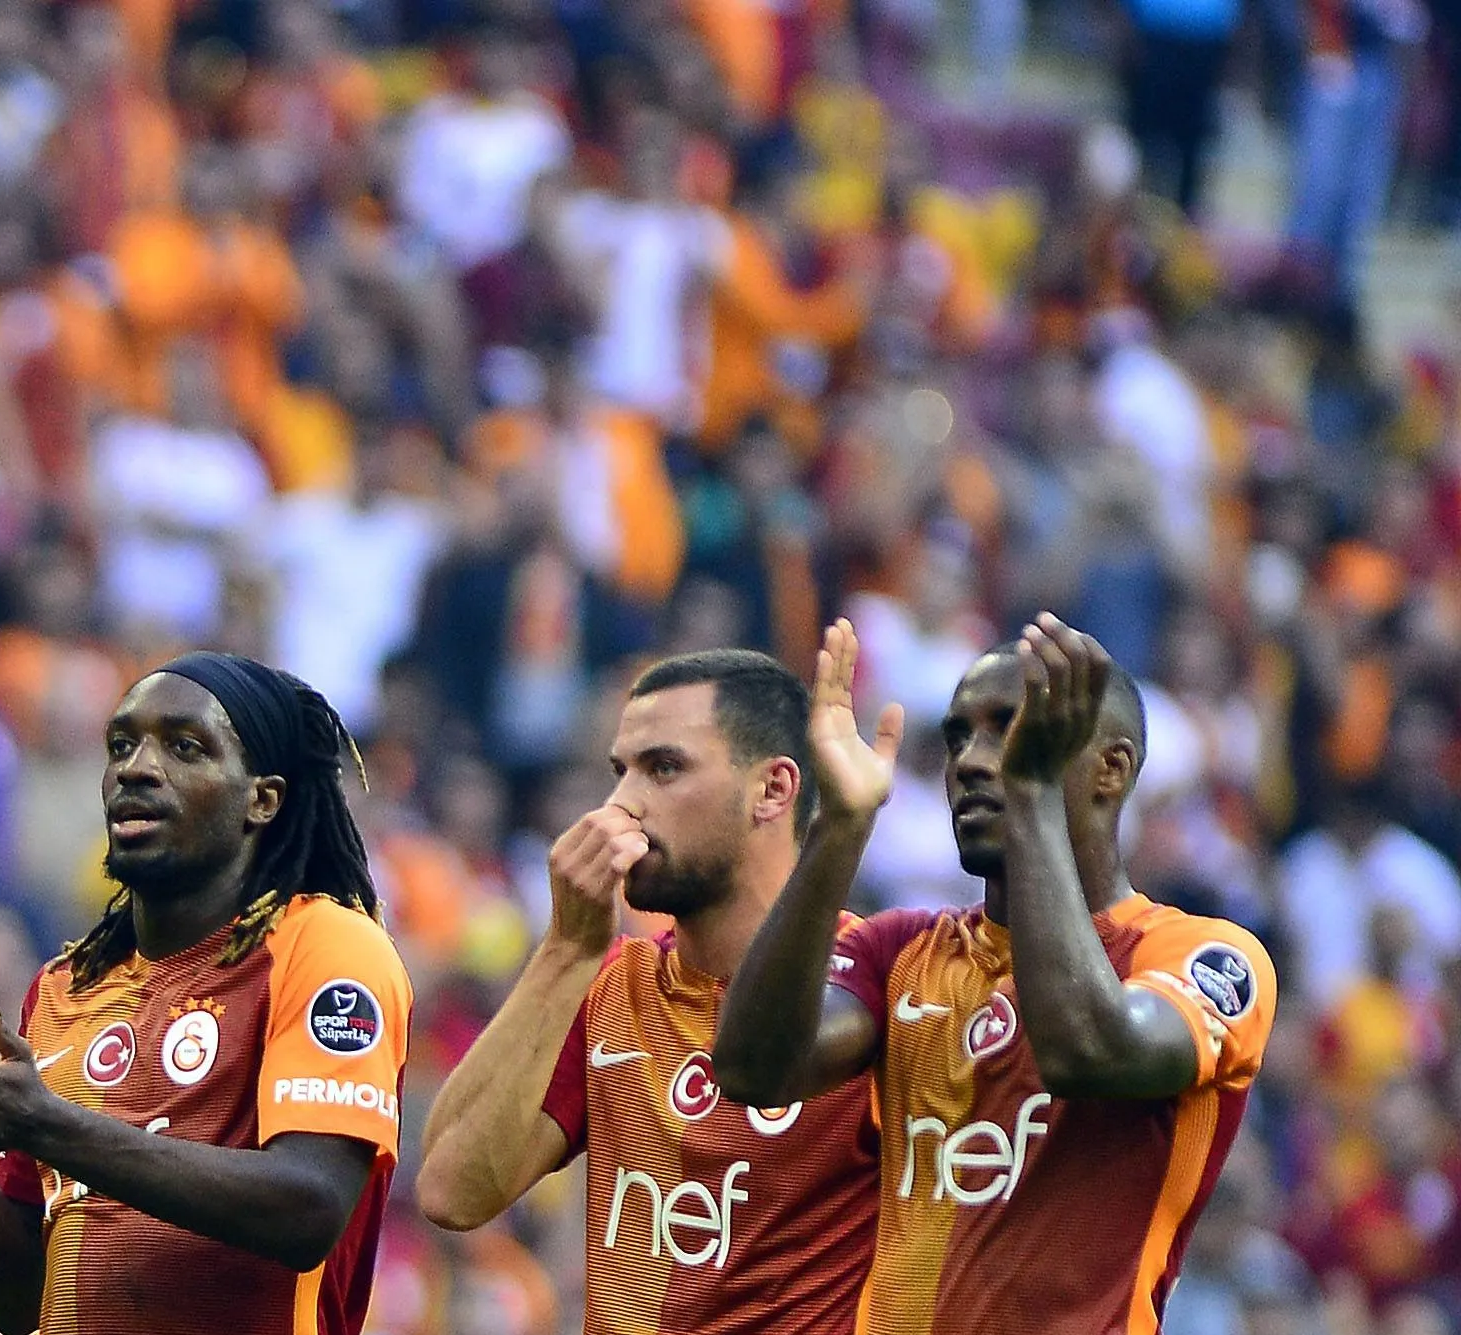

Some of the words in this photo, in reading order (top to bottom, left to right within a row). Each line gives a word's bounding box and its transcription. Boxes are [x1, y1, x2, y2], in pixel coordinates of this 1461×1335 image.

[314, 1015, 348, 1028] SPOR
[274, 1076, 398, 1121] PERMOLI
[900, 1093, 1051, 1206] nef
[604, 1161, 751, 1269] nef
